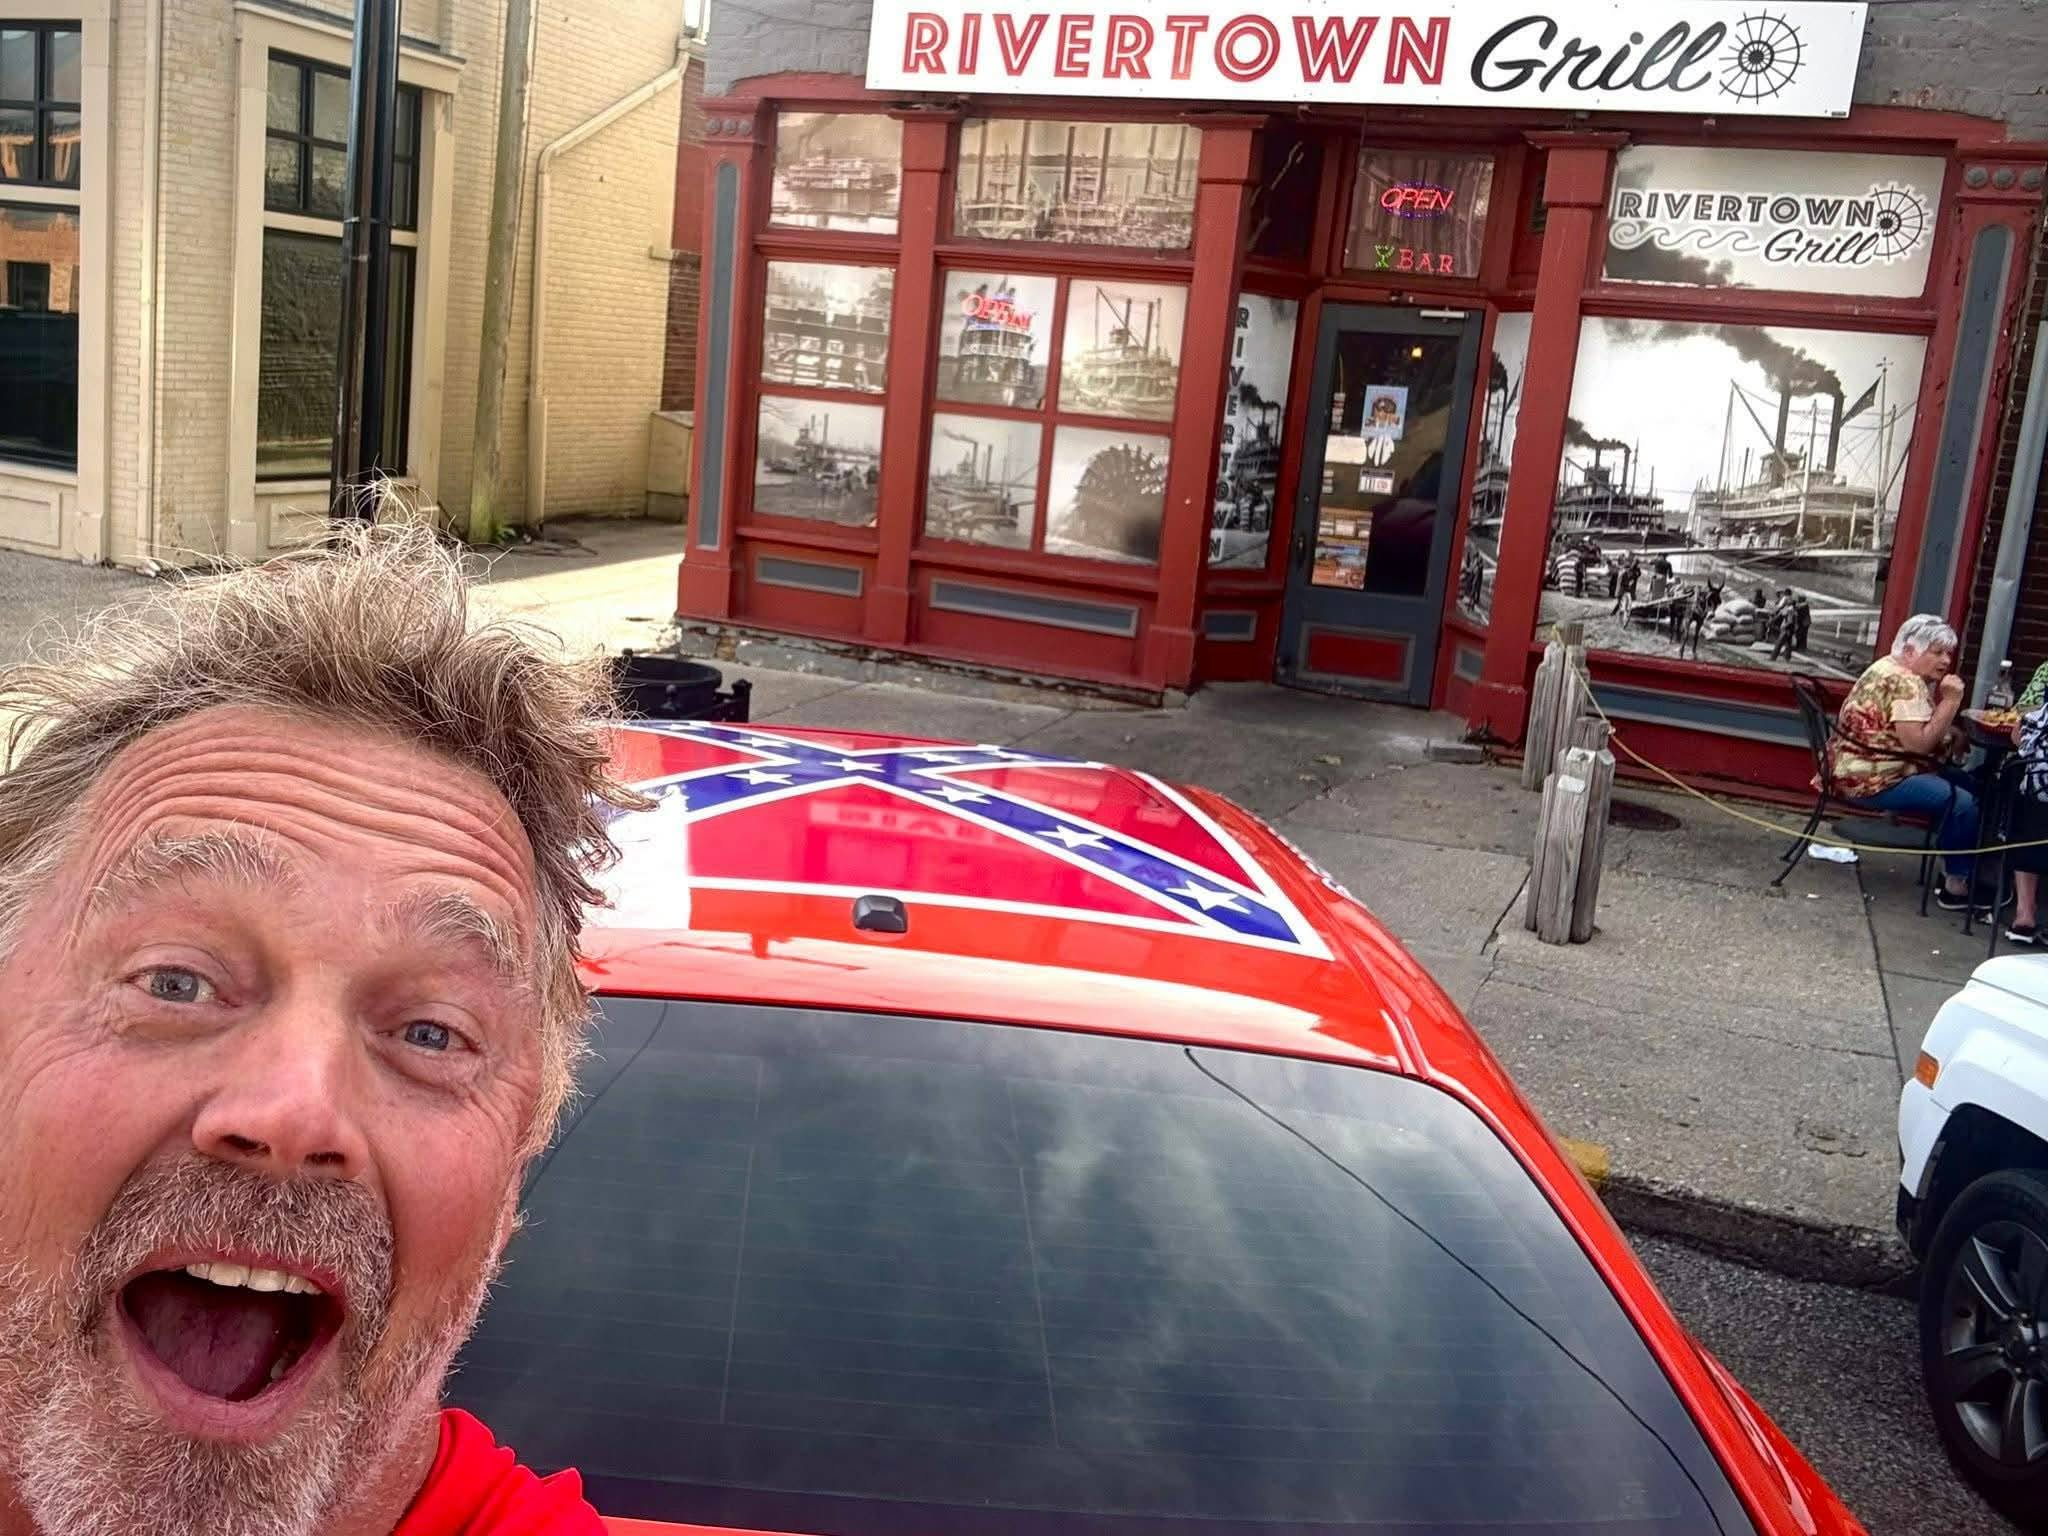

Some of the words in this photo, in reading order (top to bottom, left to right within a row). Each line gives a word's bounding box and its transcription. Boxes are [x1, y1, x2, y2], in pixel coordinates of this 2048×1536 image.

[901, 12, 1451, 86] RIVERTOWN
[1471, 15, 1728, 93] Grill
[1380, 187, 1455, 211] OPEN
[1618, 191, 1876, 227] RIVERTOWN
[1396, 248, 1454, 273] BAR
[1764, 228, 1881, 265] Grill
